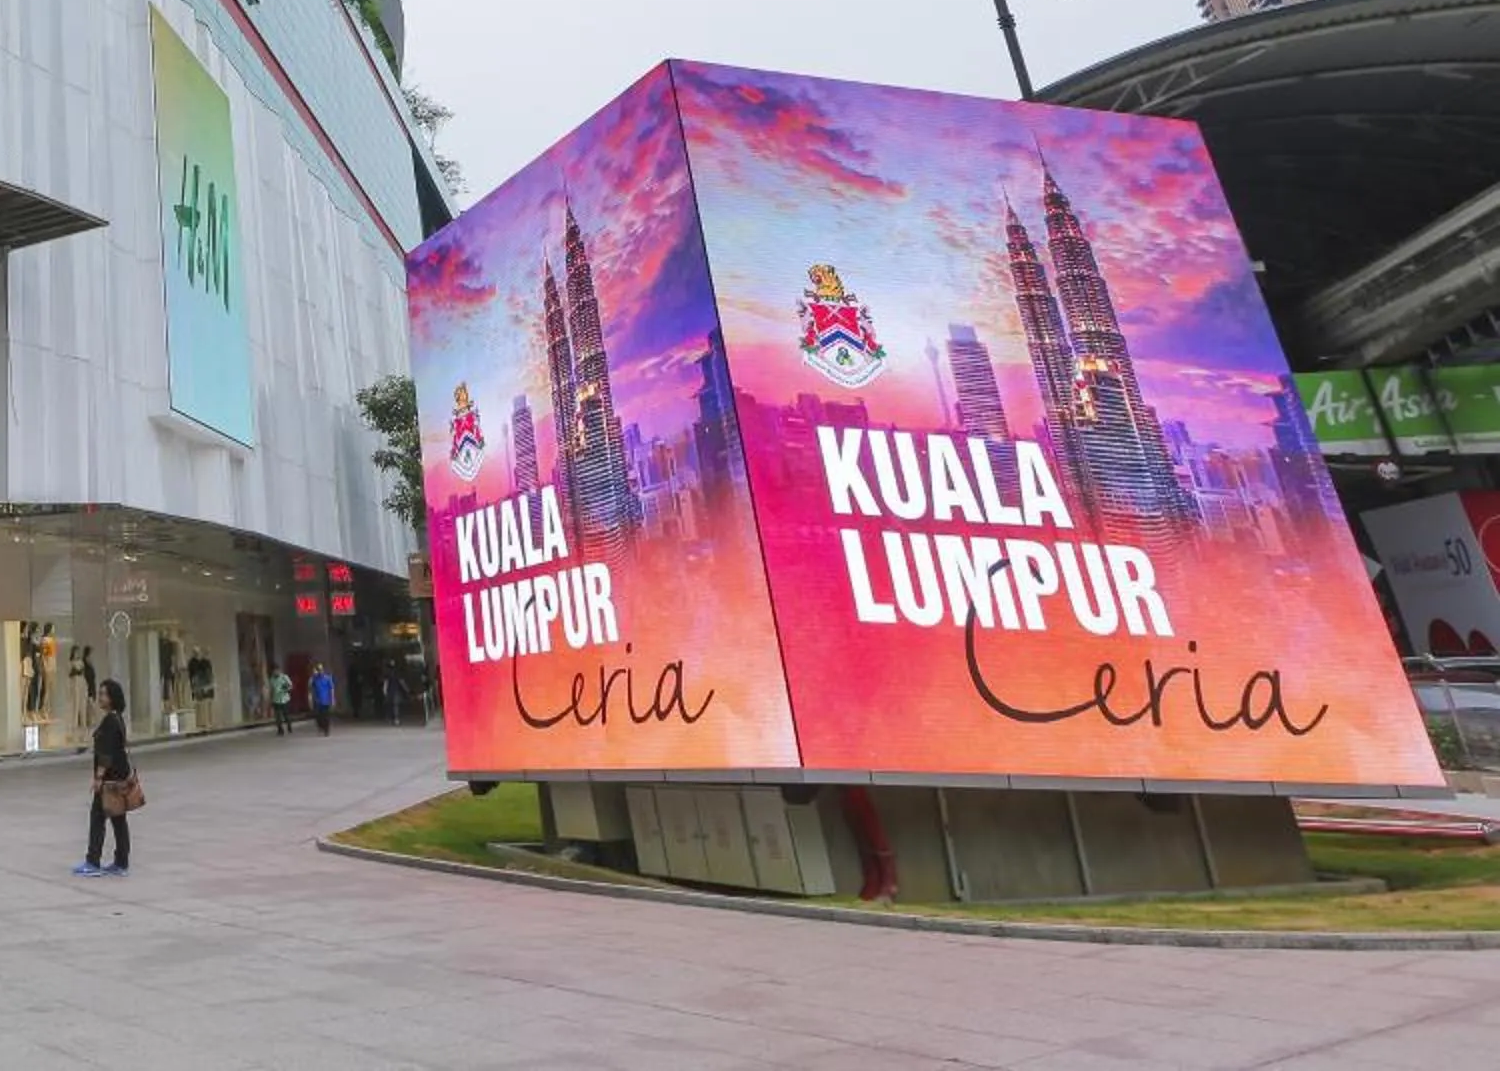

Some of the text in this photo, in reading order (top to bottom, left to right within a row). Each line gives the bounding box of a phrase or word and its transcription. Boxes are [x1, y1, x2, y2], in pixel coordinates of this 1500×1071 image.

[174, 154, 229, 313] H&M
[817, 427, 1073, 528] KUALA
[455, 484, 569, 584] KUALA
[840, 529, 1174, 637] LUMPUR
[1444, 537, 1471, 576] 50
[463, 563, 619, 664] LUMPUR
